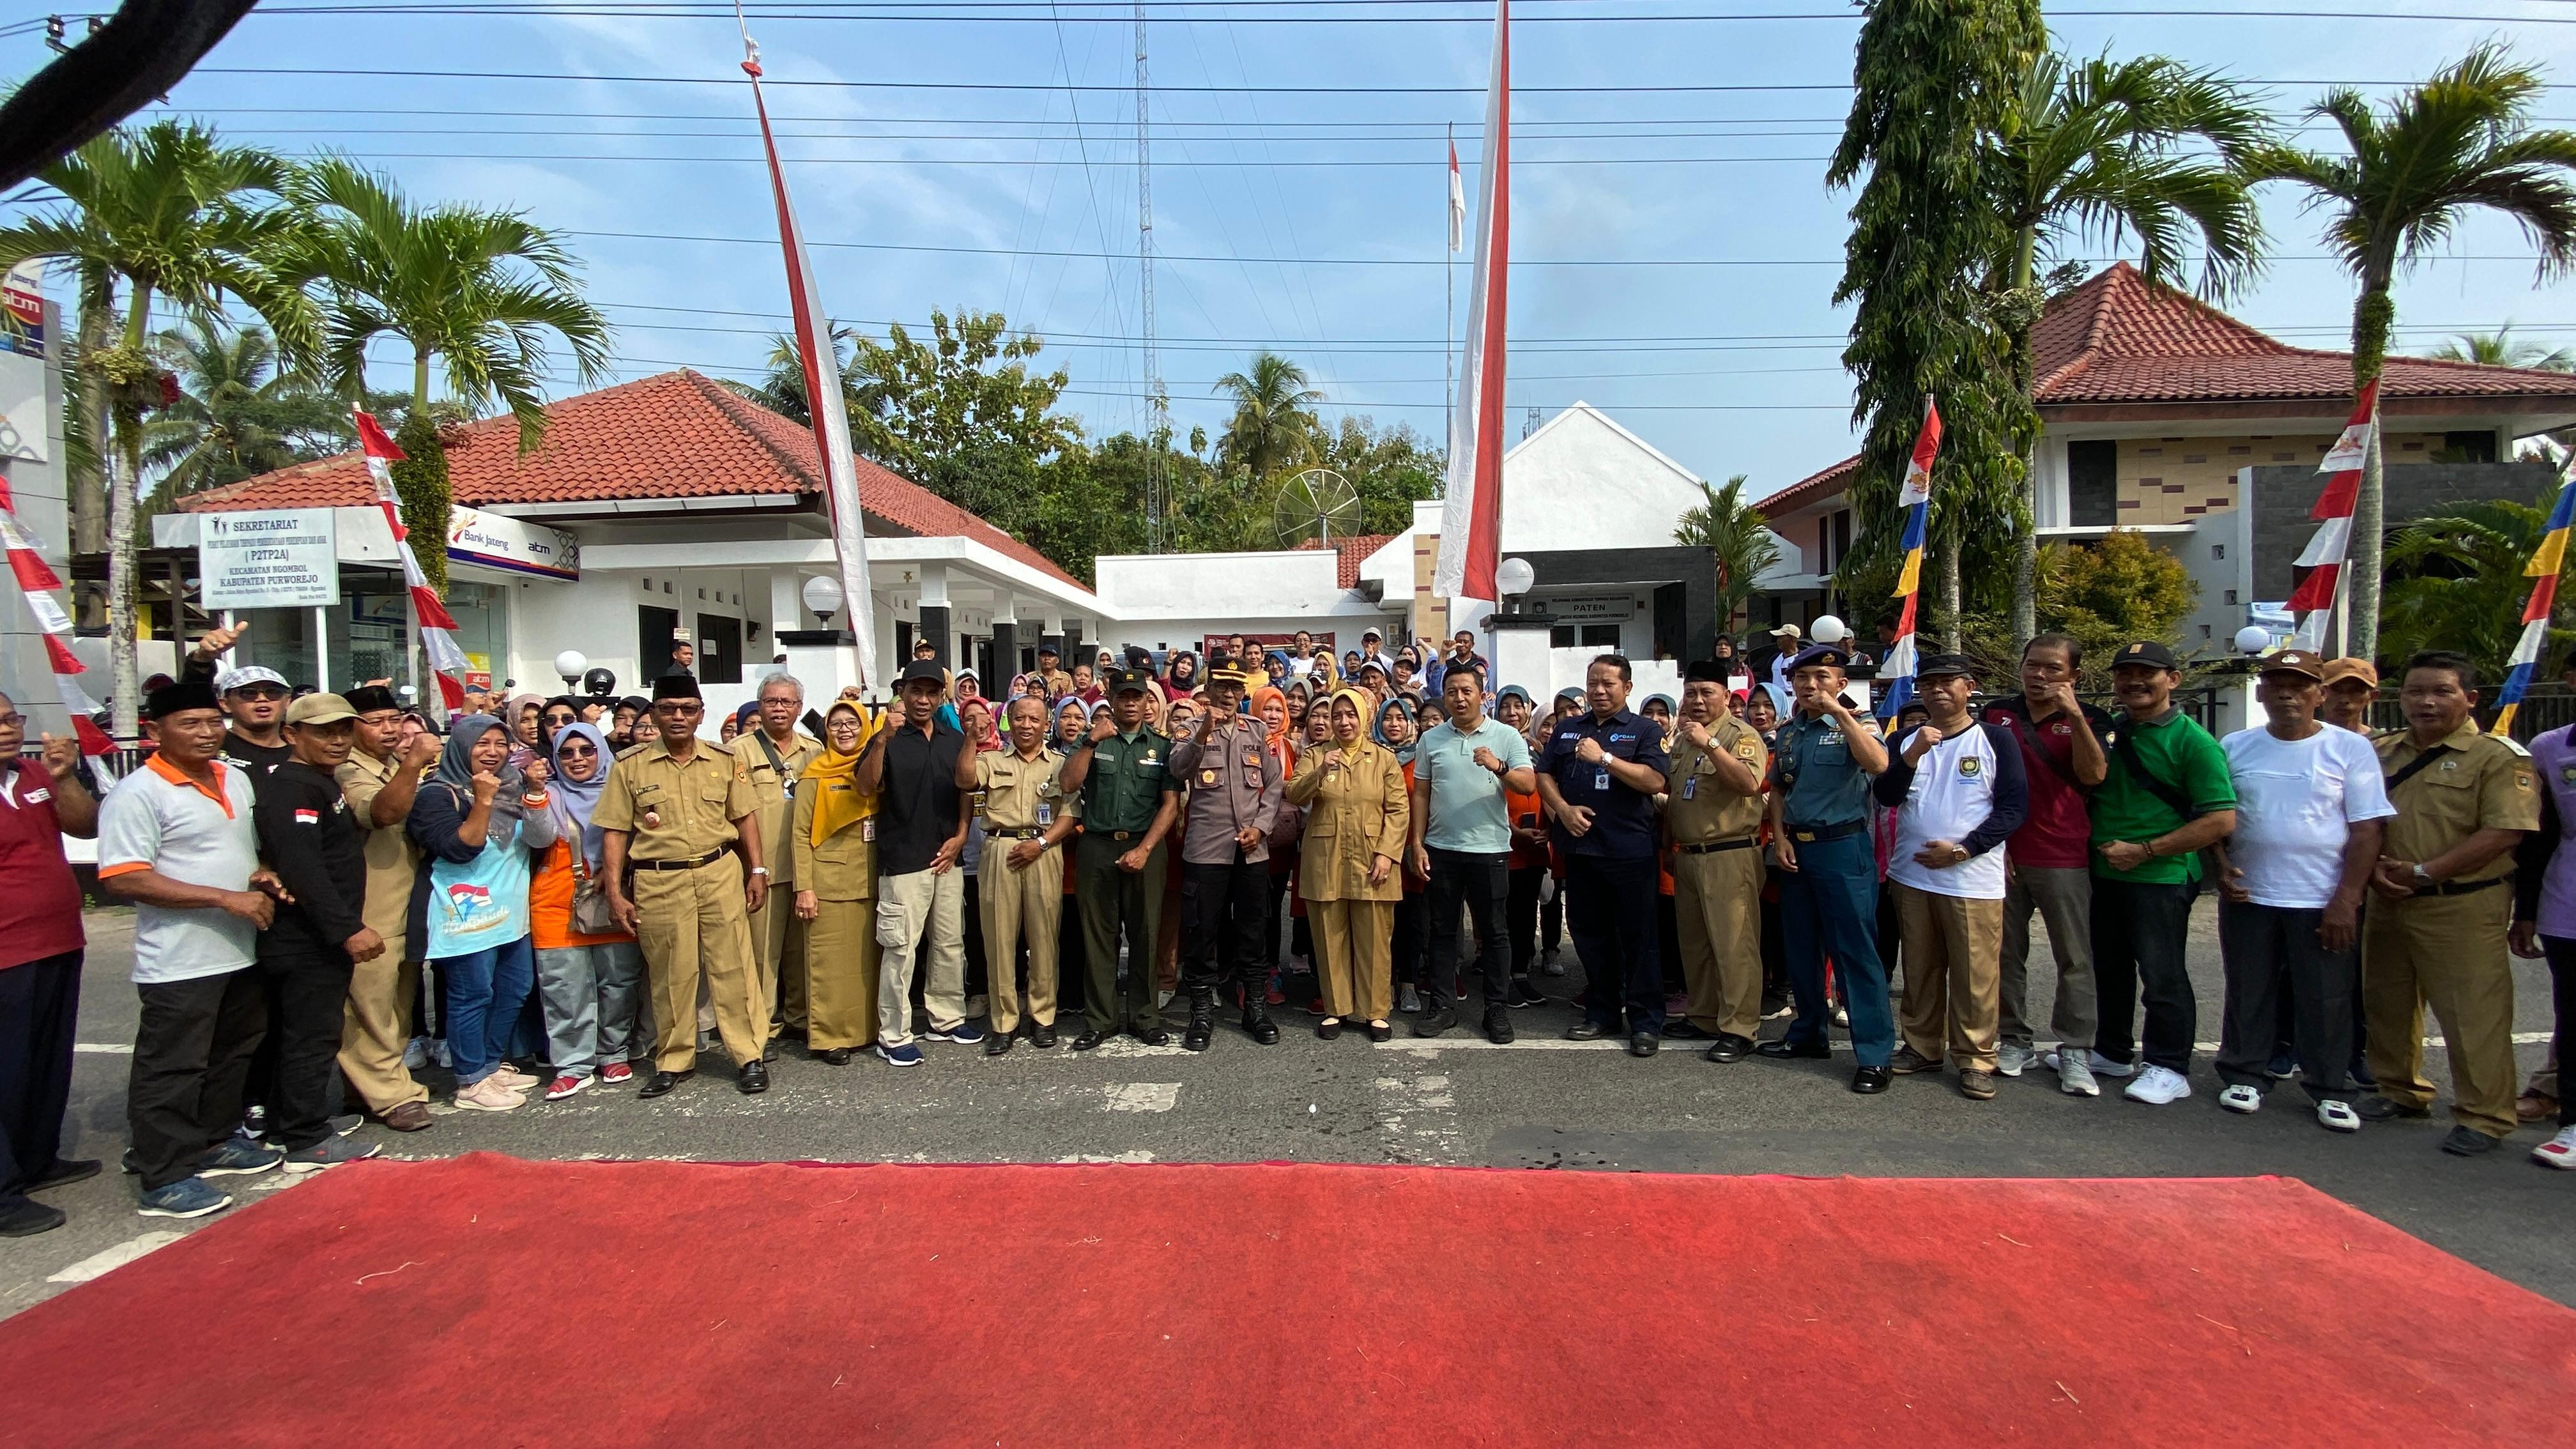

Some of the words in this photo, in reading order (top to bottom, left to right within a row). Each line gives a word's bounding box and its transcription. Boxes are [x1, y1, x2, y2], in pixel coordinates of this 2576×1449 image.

[233, 519, 298, 532] SEKRETARIAT
[464, 529, 484, 543] Bank
[485, 534, 509, 551] Jateng
[528, 542, 550, 555] atm
[229, 565, 270, 575] KECAMATAN
[272, 565, 308, 574] NGOMBOL
[220, 576, 265, 587] KABUPATEN
[268, 574, 318, 585] PURWOREJO
[1574, 604, 1606, 612] PATEN
[473, 675, 489, 683] atm
